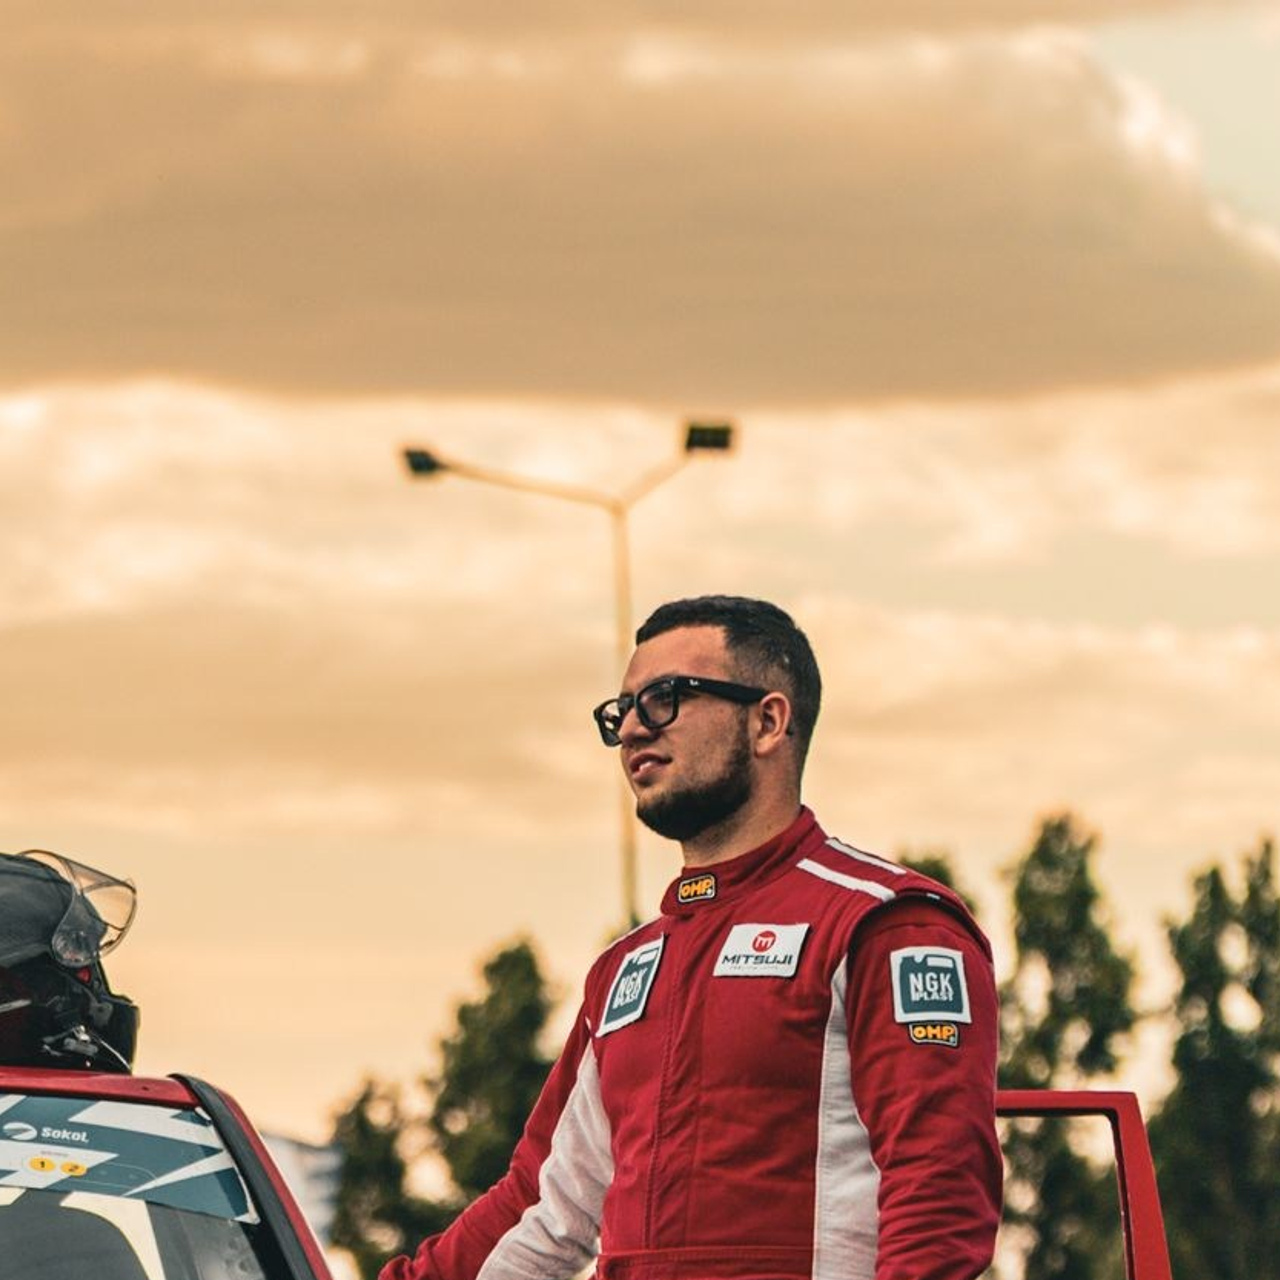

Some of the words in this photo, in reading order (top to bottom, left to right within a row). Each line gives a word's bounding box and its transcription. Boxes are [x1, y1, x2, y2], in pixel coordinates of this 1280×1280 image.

[681, 879, 712, 897] OMP
[722, 954, 793, 965] MITSUJI
[908, 972, 953, 994] NGK
[913, 1025, 955, 1039] OMP
